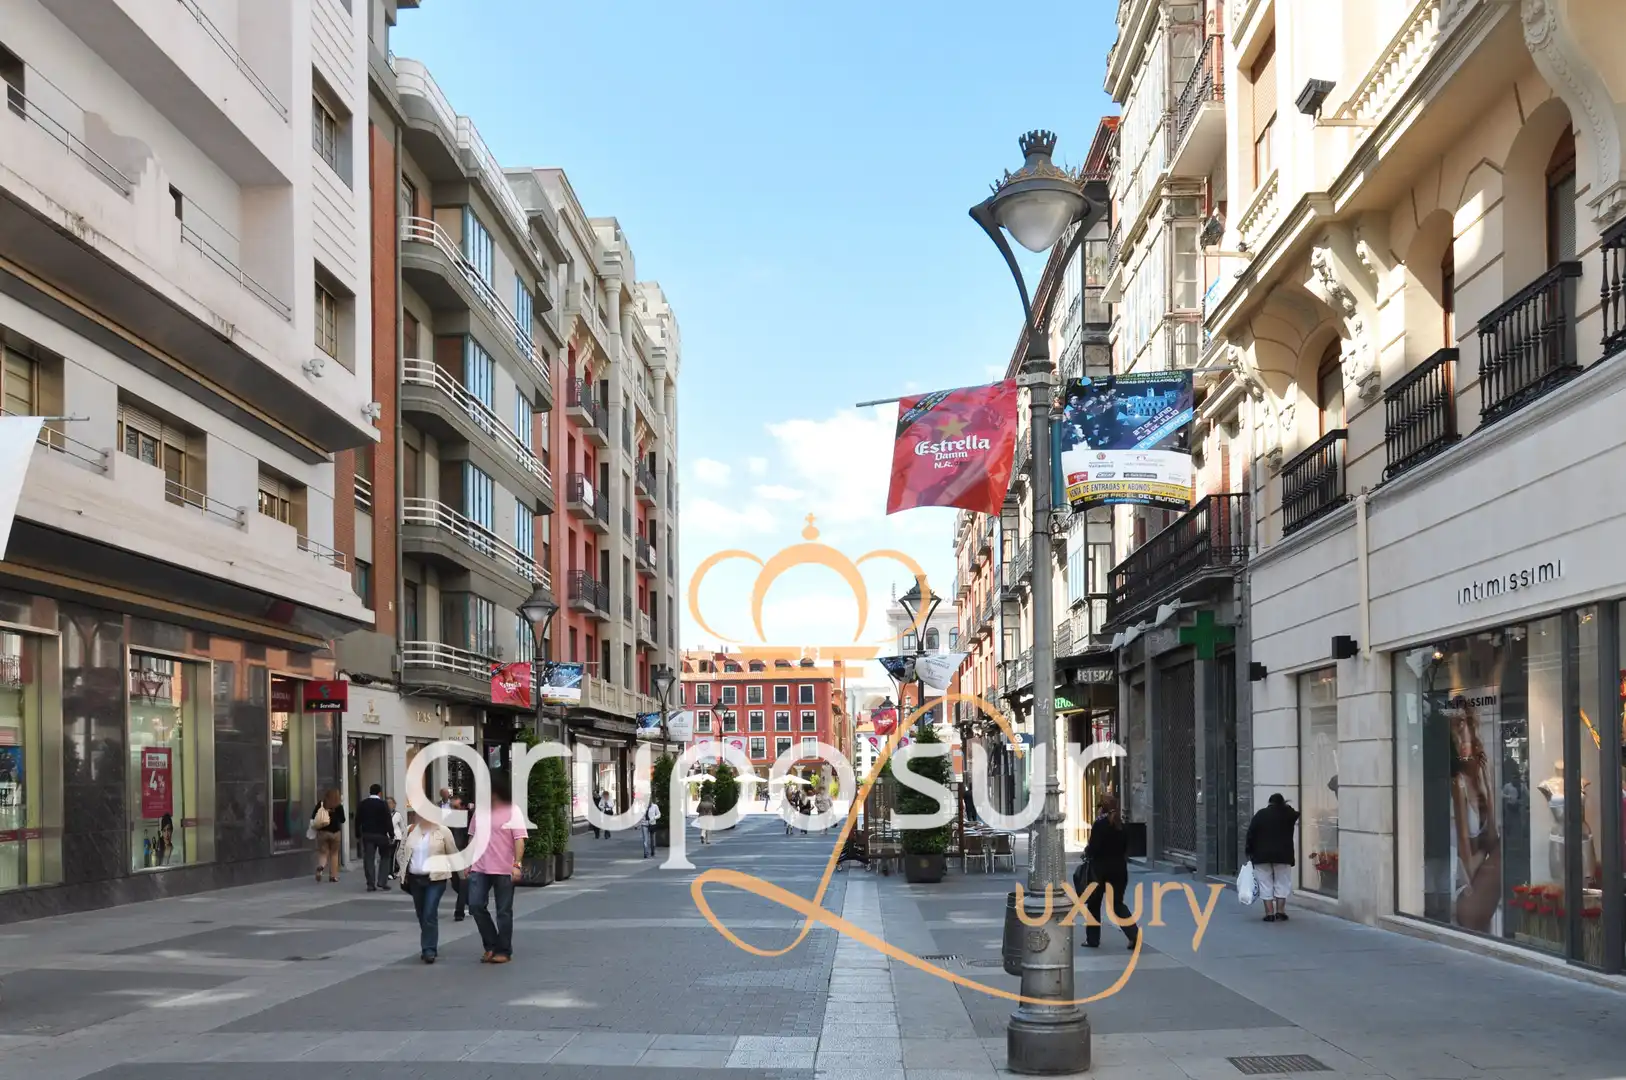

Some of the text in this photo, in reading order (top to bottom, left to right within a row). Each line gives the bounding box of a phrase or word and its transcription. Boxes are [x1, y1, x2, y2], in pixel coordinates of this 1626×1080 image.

[1132, 425, 1145, 436] 27
[1151, 406, 1173, 423] JUNIO
[1158, 409, 1179, 425] JULIO
[914, 434, 991, 456] Estrella
[935, 451, 968, 460] Damm
[1069, 487, 1081, 498] VENTA
[1083, 484, 1089, 493] DE
[1091, 482, 1121, 492] ENTRADAS
[1122, 483, 1126, 491] Y
[1128, 483, 1151, 492] ABONOS
[1085, 493, 1109, 502] MEJOR
[1155, 495, 1185, 504] MUNDO
[1457, 558, 1562, 605] intimissimi
